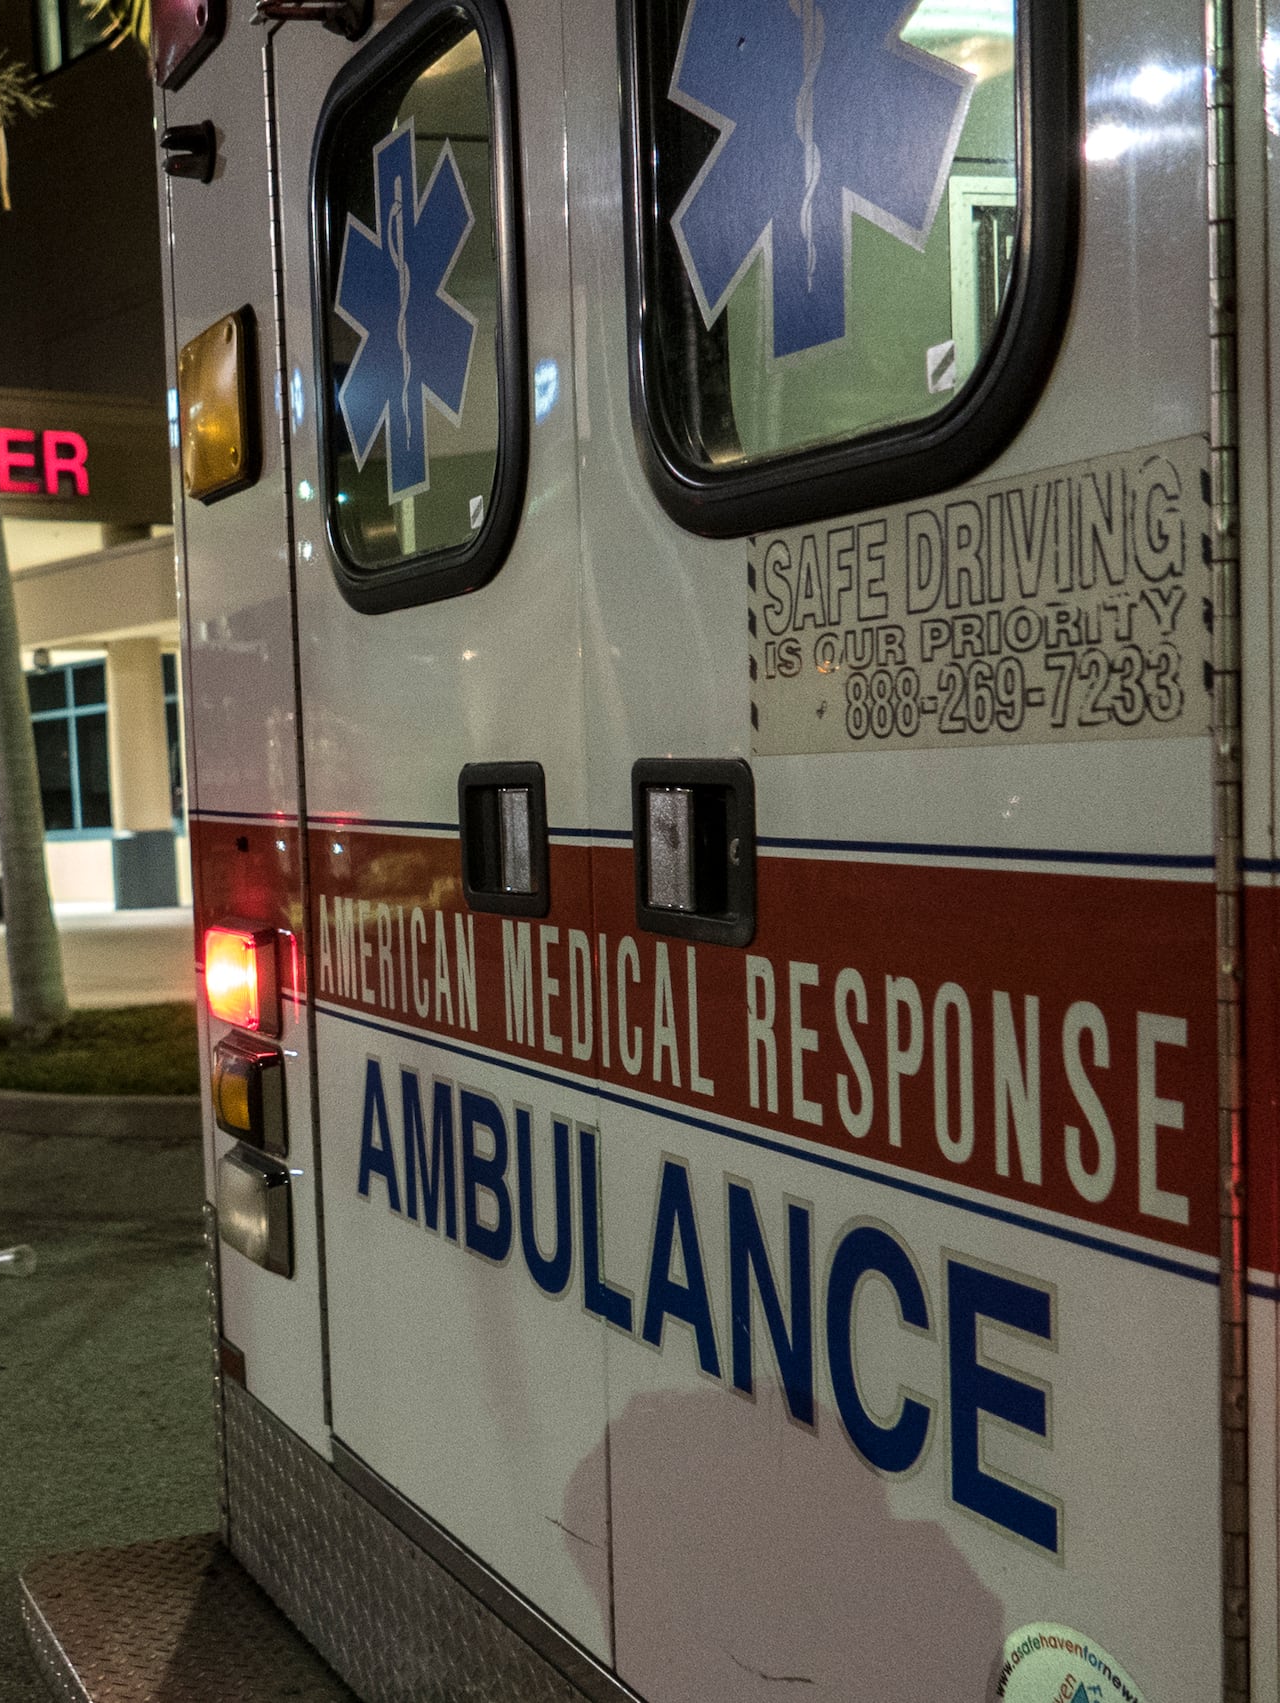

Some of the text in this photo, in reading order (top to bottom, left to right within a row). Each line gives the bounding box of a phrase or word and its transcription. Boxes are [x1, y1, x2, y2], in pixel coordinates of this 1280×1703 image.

[763, 455, 1186, 636] SAFE DRIVING
[765, 584, 1186, 680] IS OUR PRIORITY
[845, 641, 1185, 740] 888-269-7233
[320, 894, 1191, 1226] AMERICAN MEDICAL RESPONSE
[356, 1052, 1066, 1569] AMBULANCE
